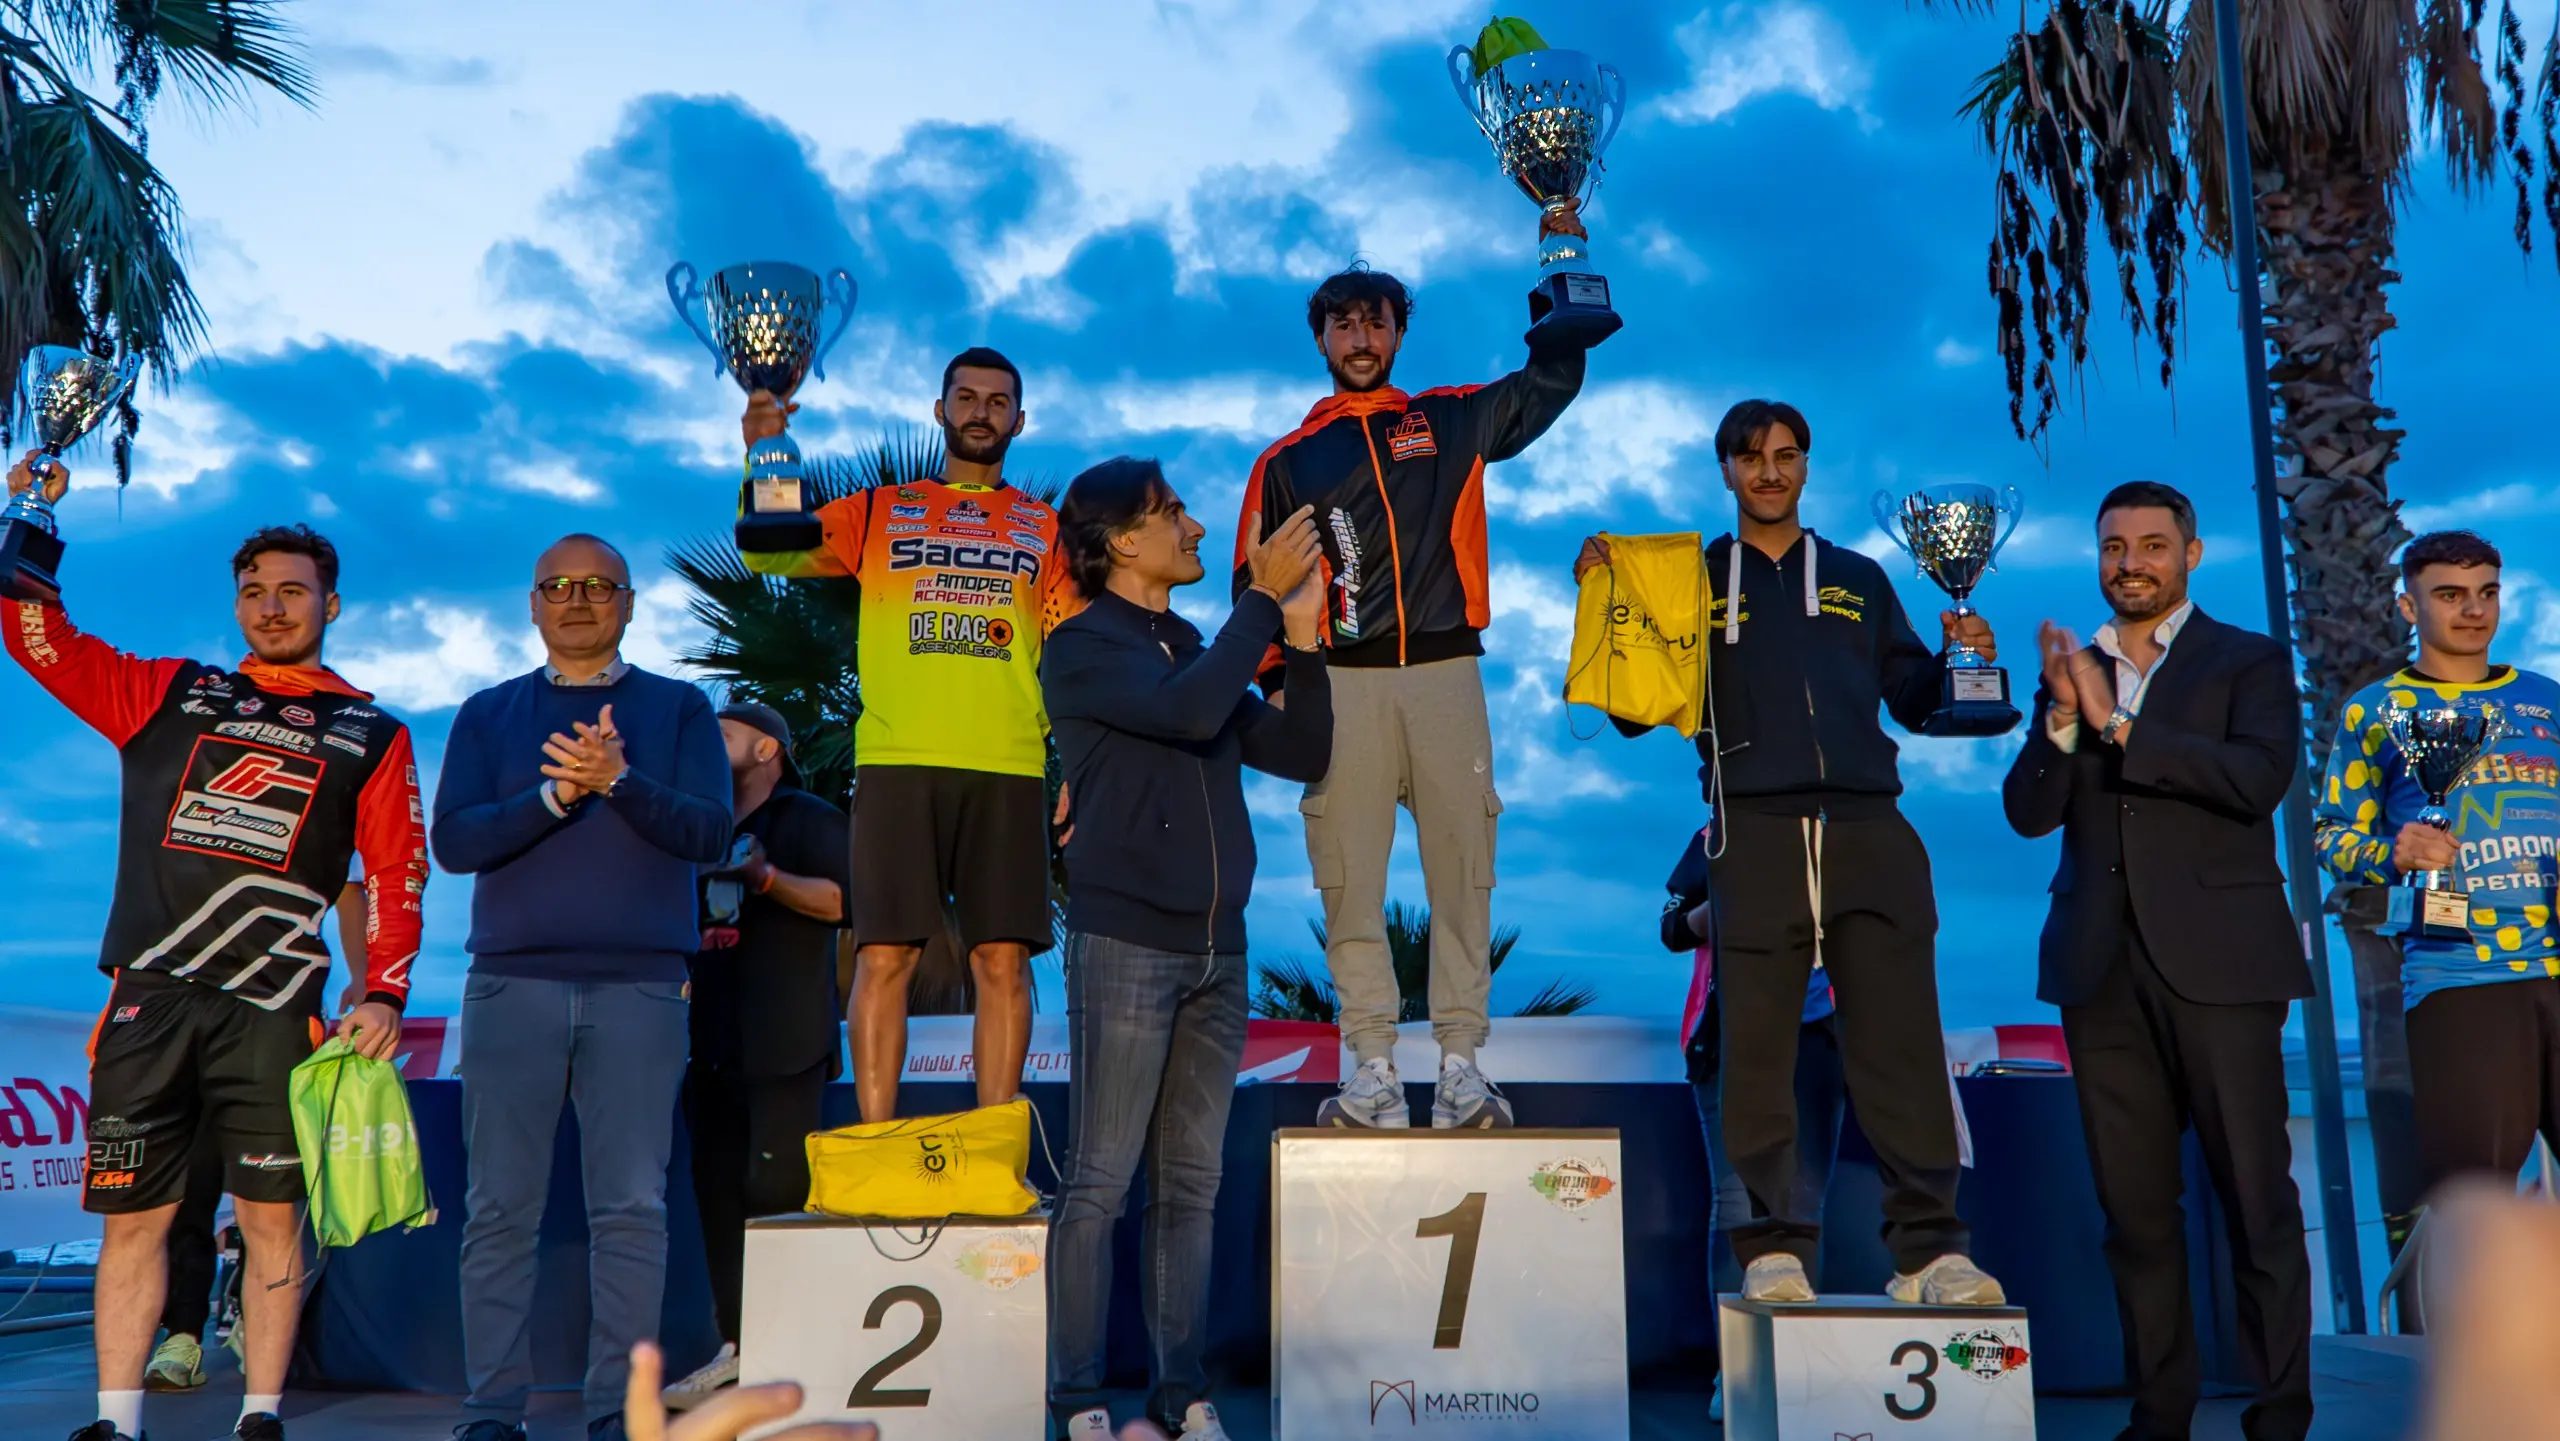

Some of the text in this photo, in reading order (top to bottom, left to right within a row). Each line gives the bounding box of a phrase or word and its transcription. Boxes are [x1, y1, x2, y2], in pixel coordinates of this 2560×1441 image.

[926, 538, 1012, 551] RACING TEAM
[913, 590, 996, 607] ACADEMY
[911, 612, 936, 642] DE
[910, 643, 1011, 661] CASE IN LEGNO
[171, 832, 285, 862] SCUOLA CROSS
[2460, 835, 2560, 873] CORON
[89, 1139, 146, 1170] 241
[90, 1171, 136, 1187] KTM
[1415, 1192, 1488, 1350] 1
[846, 1285, 943, 1409] 2
[1958, 1345, 2015, 1360] ENDURO
[1884, 1340, 1939, 1421] 3
[1424, 1392, 1540, 1413] MARTINO
